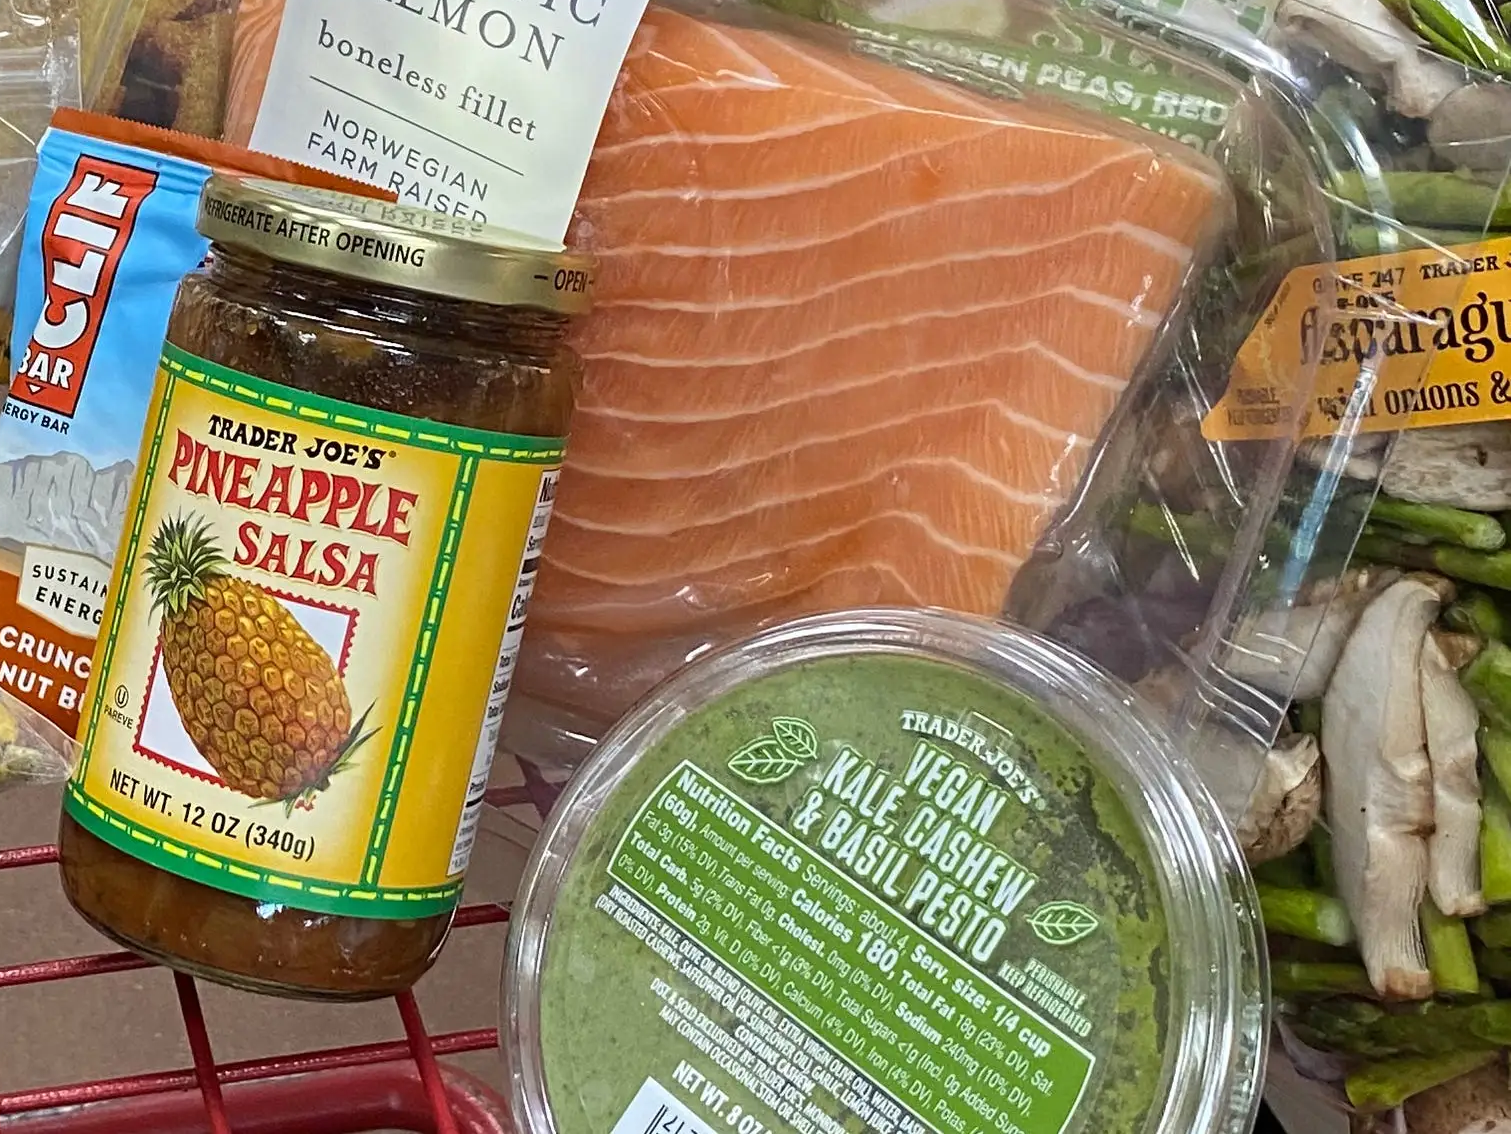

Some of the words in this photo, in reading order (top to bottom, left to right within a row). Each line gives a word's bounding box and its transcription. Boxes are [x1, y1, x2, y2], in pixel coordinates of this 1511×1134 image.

[317, 19, 447, 100] boneless
[459, 84, 538, 141] fillet
[306, 132, 378, 181] FARM
[389, 172, 488, 225] RAISED
[322, 110, 489, 201] NORWEGIAN
[30, 172, 128, 351] CLIF
[279, 217, 329, 249] AFTER
[335, 229, 425, 269] OPENING
[1420, 255, 1500, 281] TRADER
[17, 348, 75, 390] BAR
[1385, 382, 1479, 415] onions
[207, 414, 297, 455] TRADER
[168, 428, 419, 547] PINEAPPLE
[233, 522, 380, 598] SALSA
[104, 701, 134, 730] PAREVE
[900, 710, 986, 759] TRADER
[109, 770, 139, 800] NET
[143, 786, 176, 819] WT.
[181, 801, 207, 830] 12
[211, 813, 241, 838] OZ
[244, 822, 316, 863] (340g)
[817, 744, 919, 838] KALE,
[898, 799, 1037, 921] CASHEW
[895, 737, 1011, 840] VEGAN
[674, 768, 756, 837] Nutrition
[748, 823, 807, 874] Facts
[797, 862, 863, 920] Servings:
[907, 942, 956, 986] Serv.
[949, 973, 995, 1014] size:
[987, 1001, 1022, 1035] 1/4
[1013, 1025, 1053, 1061] cup
[788, 786, 833, 835] &
[815, 803, 921, 899] BASIL
[900, 867, 1011, 967] PESTO
[788, 886, 857, 944] Calories
[849, 928, 906, 981] 180,
